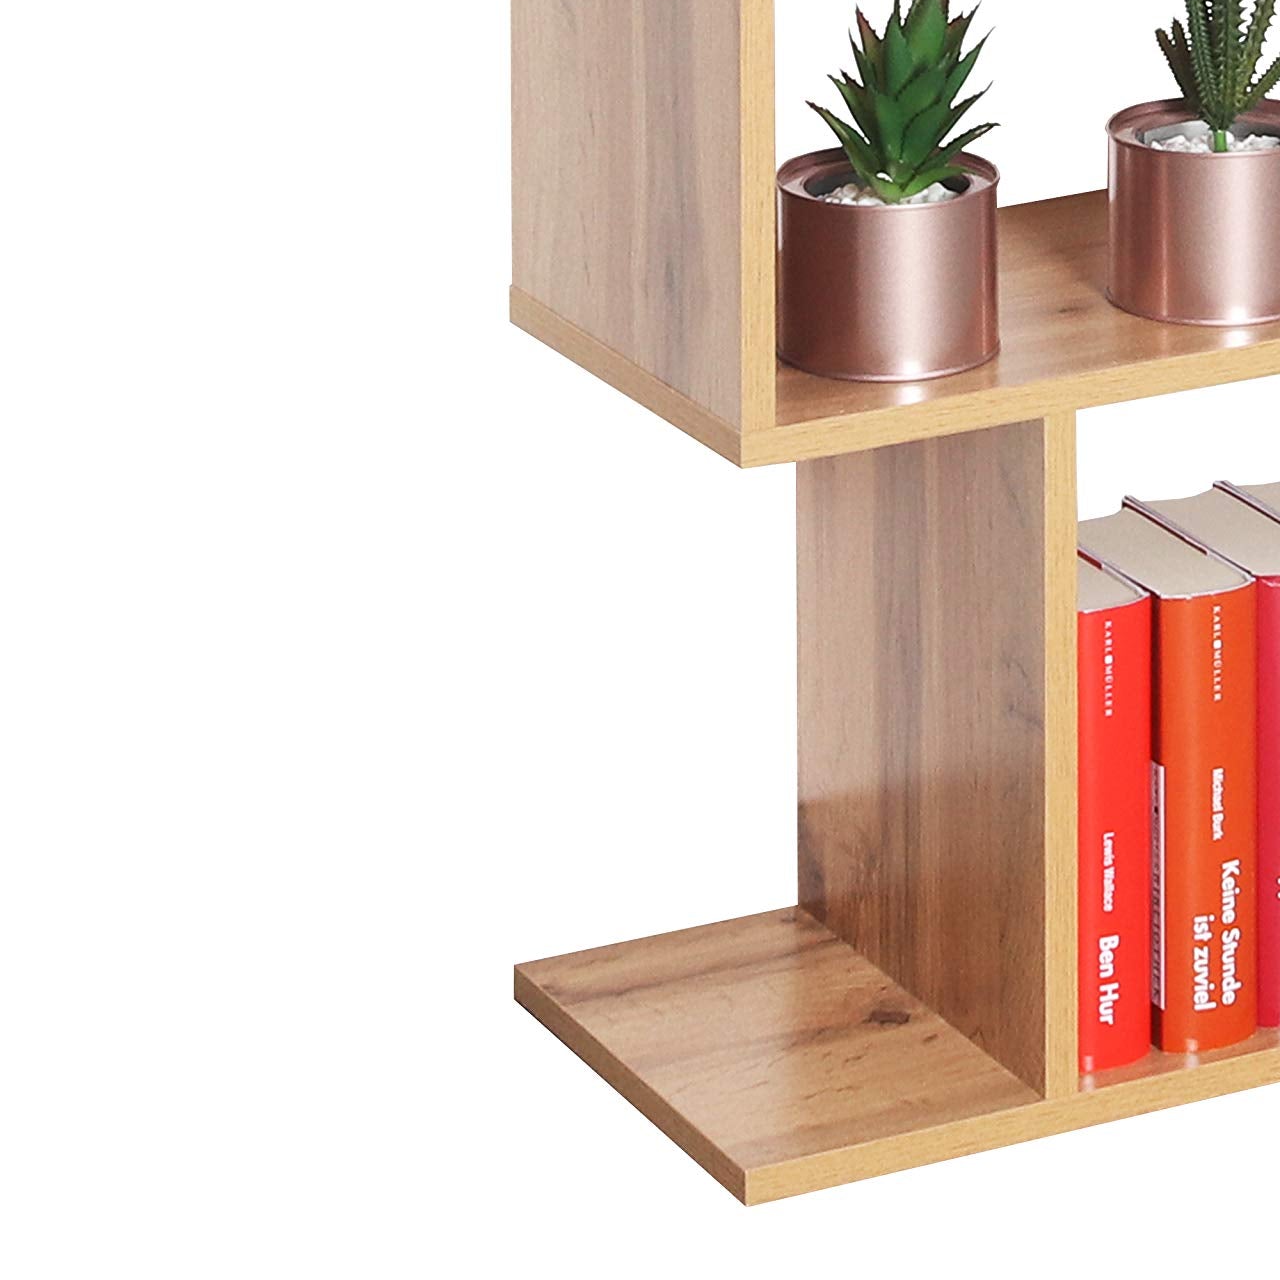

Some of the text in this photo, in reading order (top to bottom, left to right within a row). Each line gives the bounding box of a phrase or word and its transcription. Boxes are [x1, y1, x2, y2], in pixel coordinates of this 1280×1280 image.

[1212, 768, 1224, 841] Michael Burk
[1103, 831, 1115, 912] Lewis Wallace
[1193, 914, 1217, 1011] ist zuviel
[1221, 859, 1242, 1005] Keine Stunde
[1098, 934, 1120, 1025] Ben Hur
